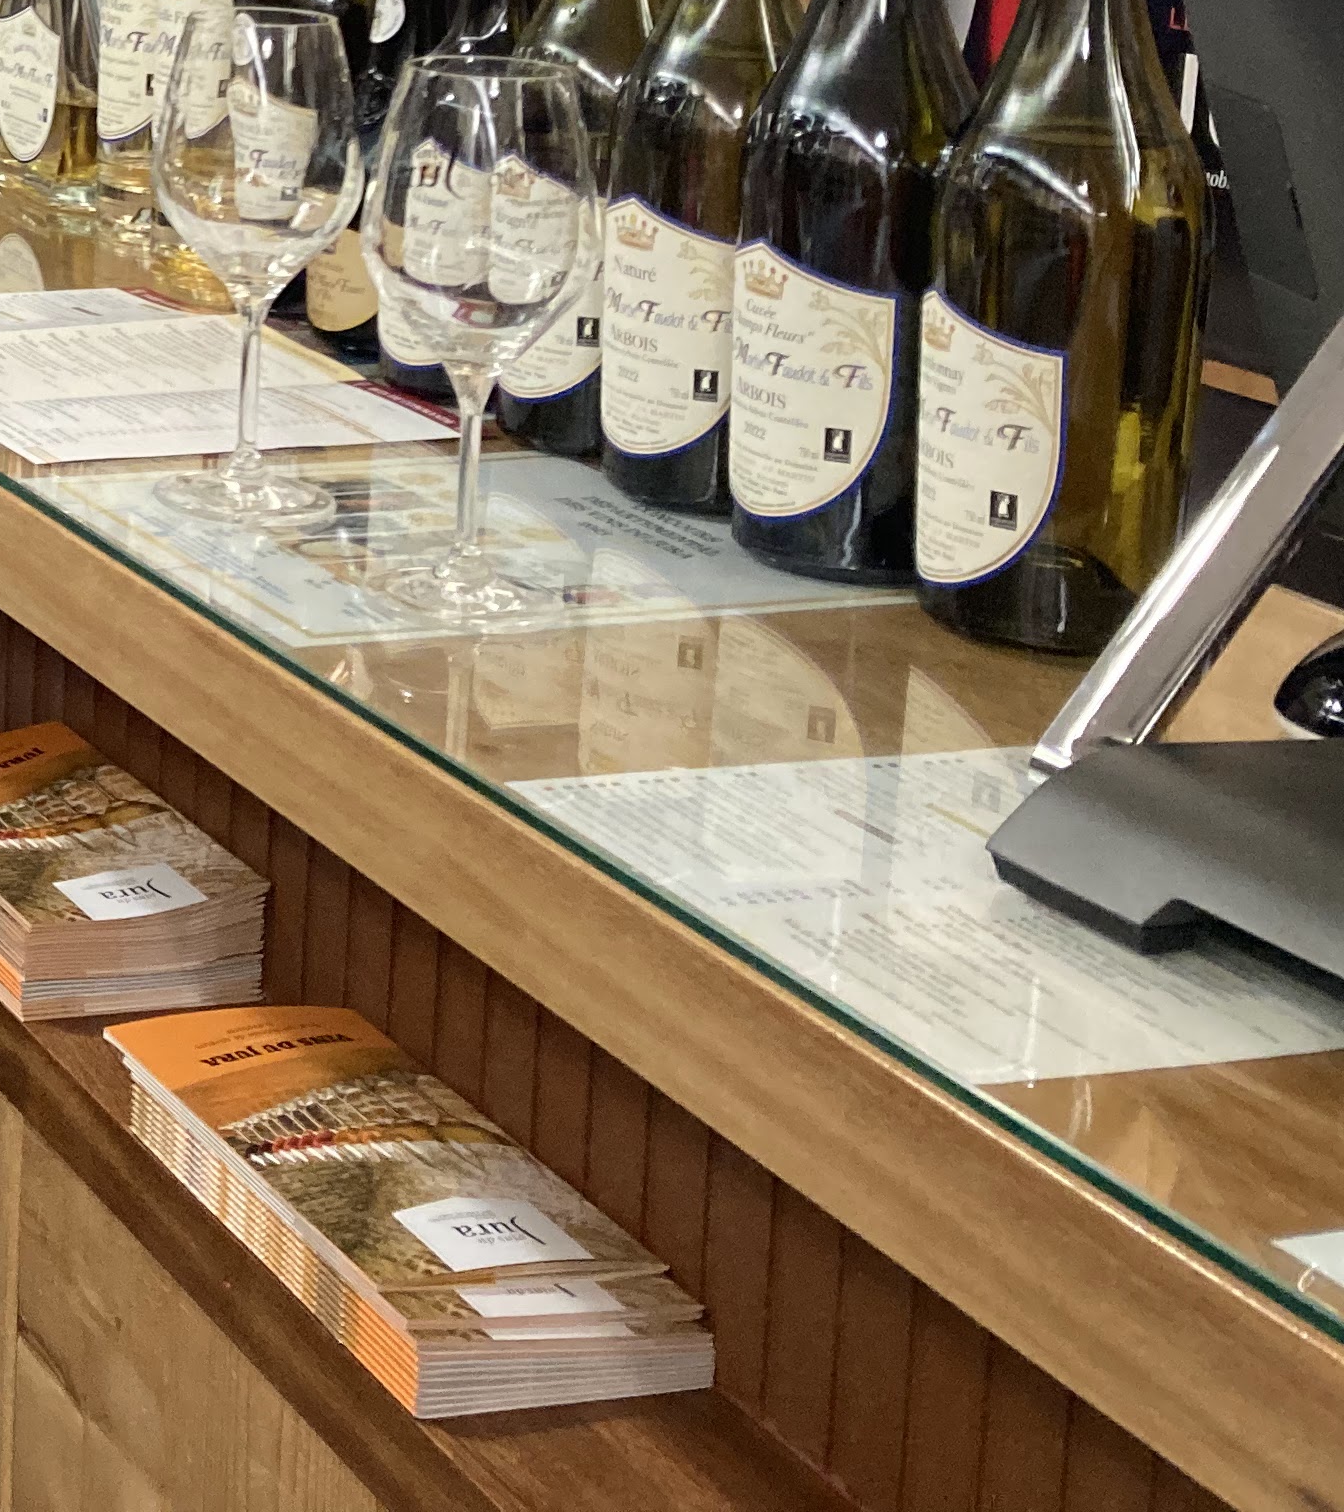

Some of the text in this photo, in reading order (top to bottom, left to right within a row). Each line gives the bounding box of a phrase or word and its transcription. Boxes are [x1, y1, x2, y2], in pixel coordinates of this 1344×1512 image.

[98, 877, 172, 900] Jura
[199, 1044, 264, 1067] JURA
[262, 1040, 298, 1054] DU
[451, 1215, 546, 1246] Jura
